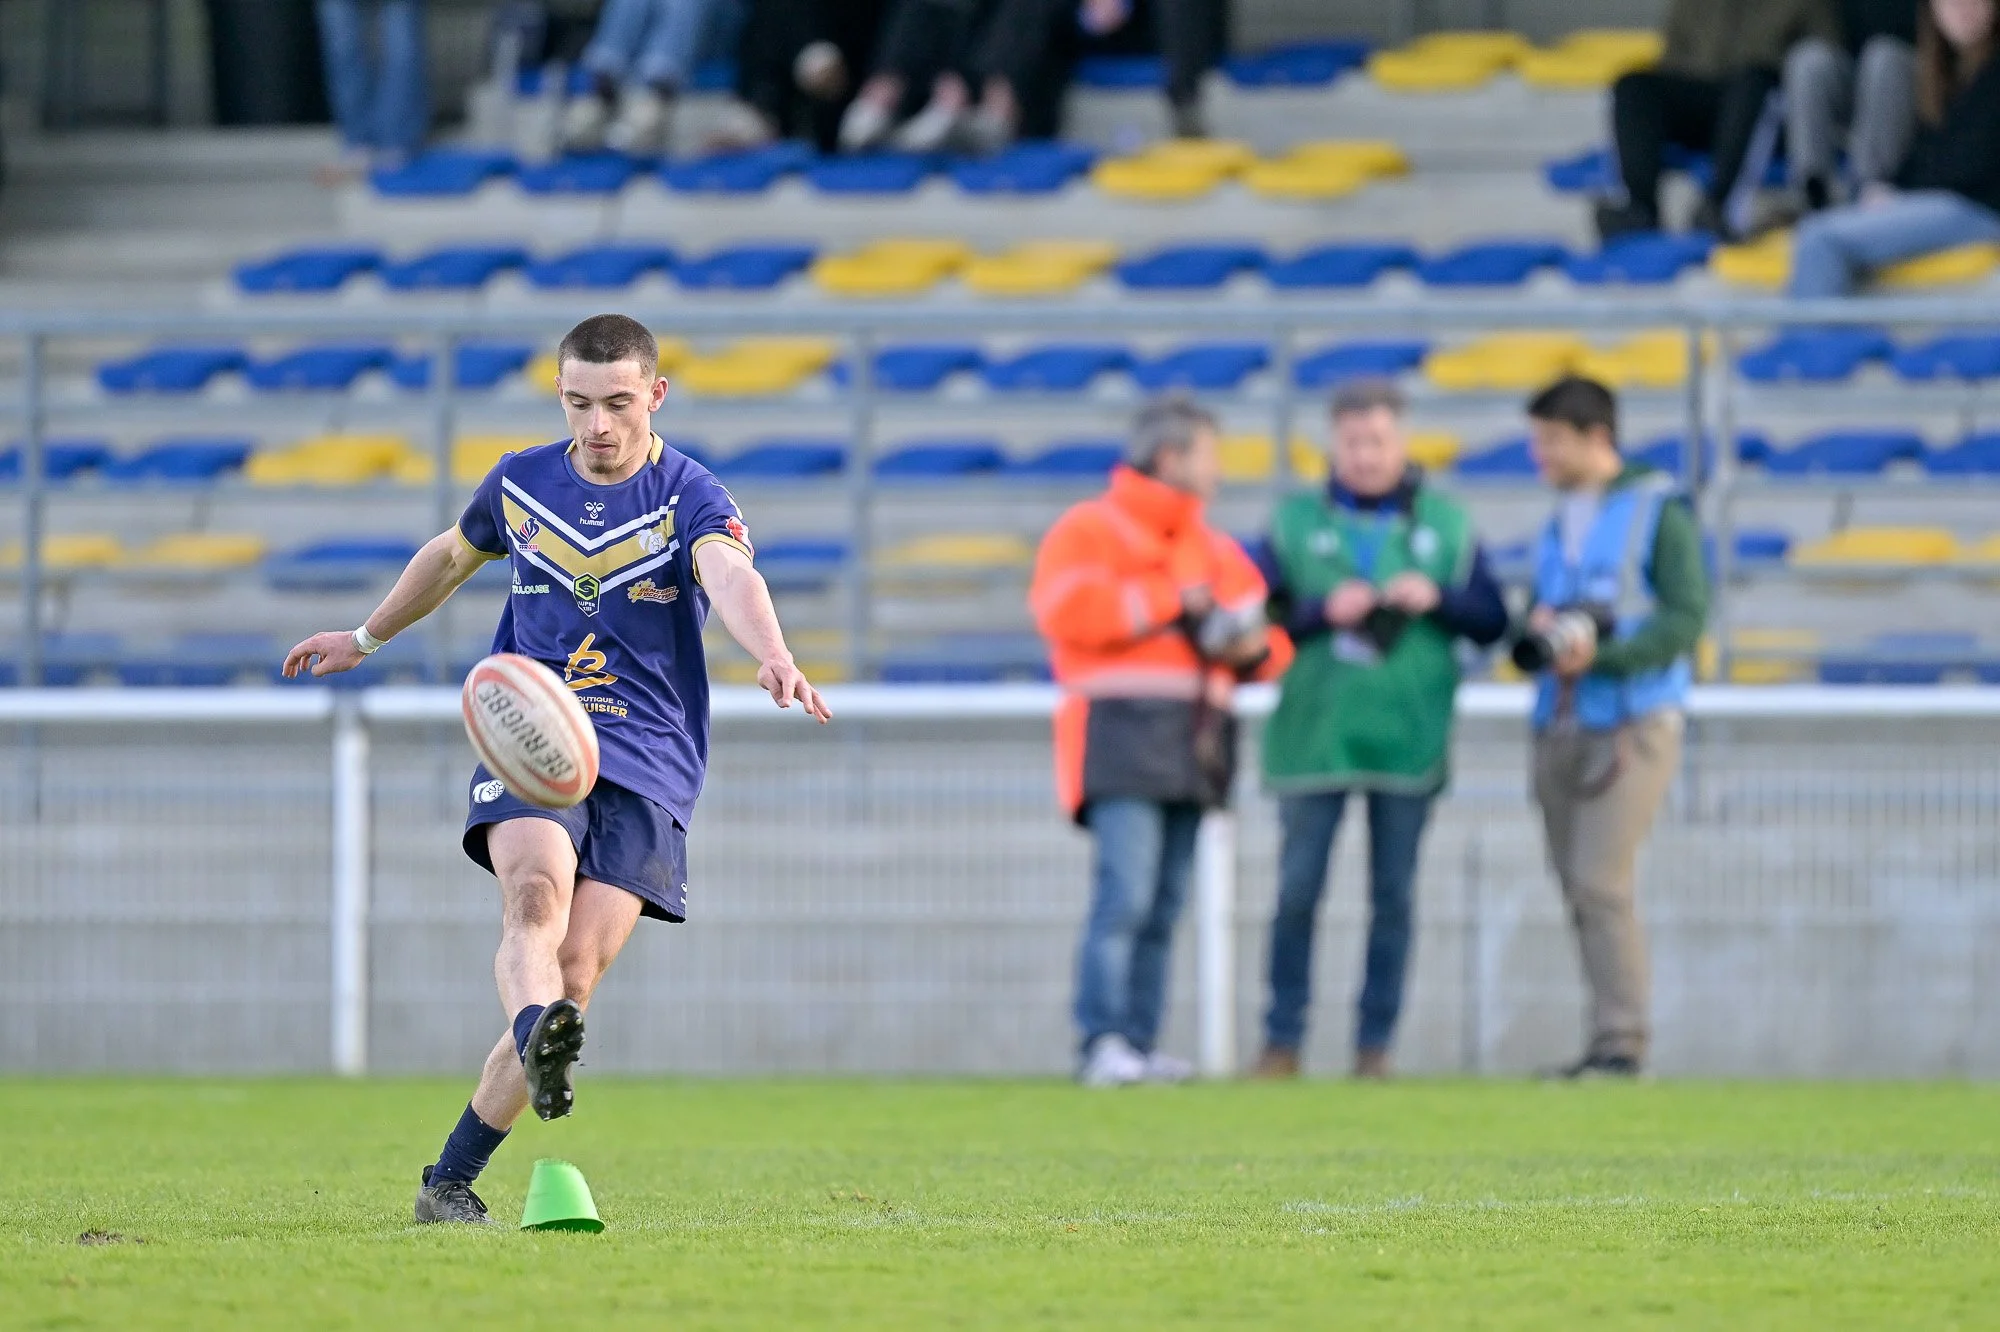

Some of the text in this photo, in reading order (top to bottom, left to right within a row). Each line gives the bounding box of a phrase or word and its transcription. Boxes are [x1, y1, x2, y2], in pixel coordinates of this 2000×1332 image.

[579, 516, 605, 527] hummel
[576, 695, 629, 707] OUTIQUE DU
[582, 702, 628, 719] UISIER
